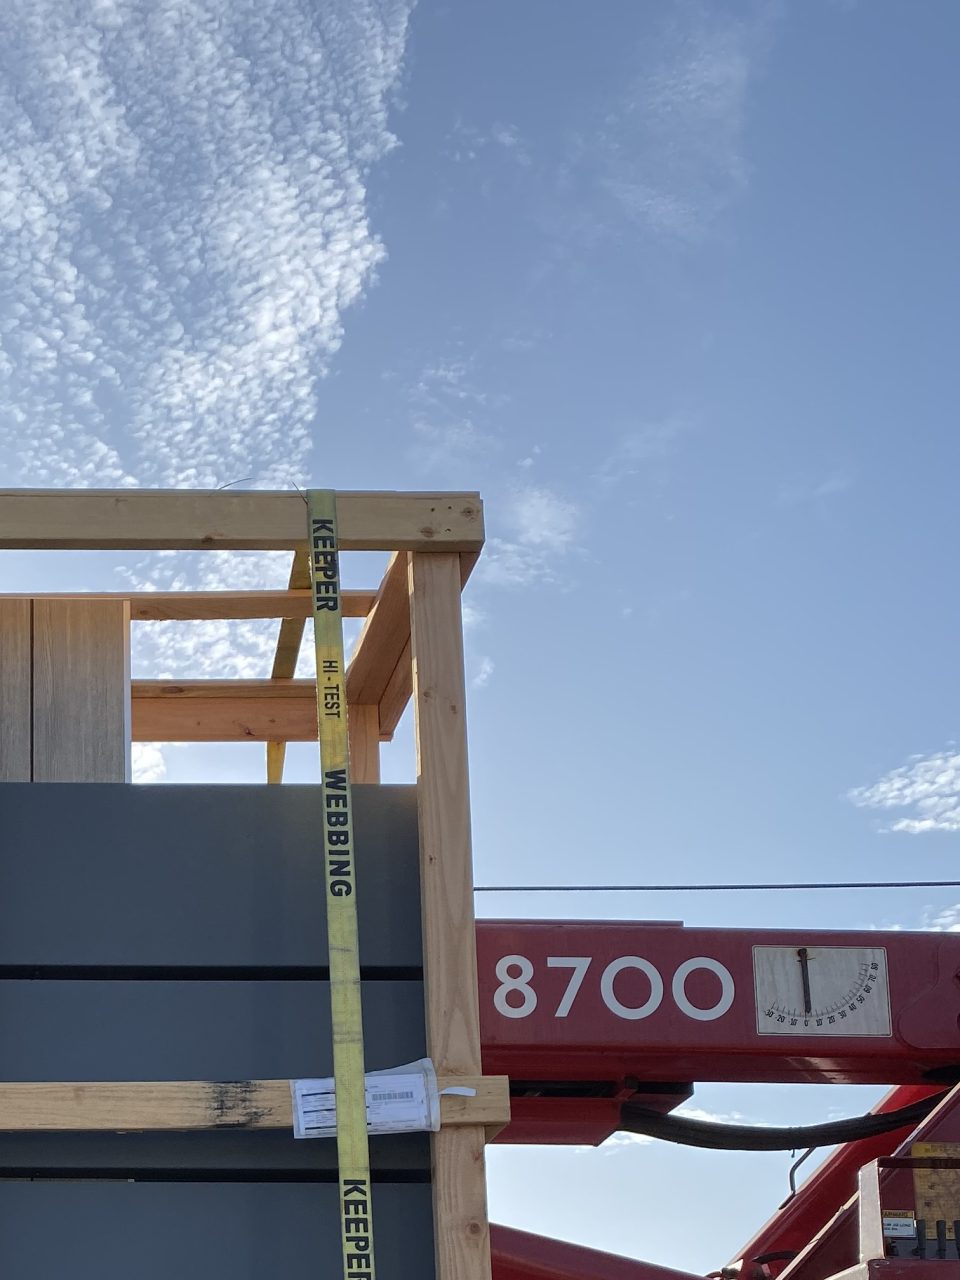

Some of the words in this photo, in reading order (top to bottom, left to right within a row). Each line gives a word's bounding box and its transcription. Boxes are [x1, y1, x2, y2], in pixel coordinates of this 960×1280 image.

[312, 519, 338, 611] KEEPER
[325, 769, 352, 897] WEBBING
[493, 955, 735, 1021] 8700
